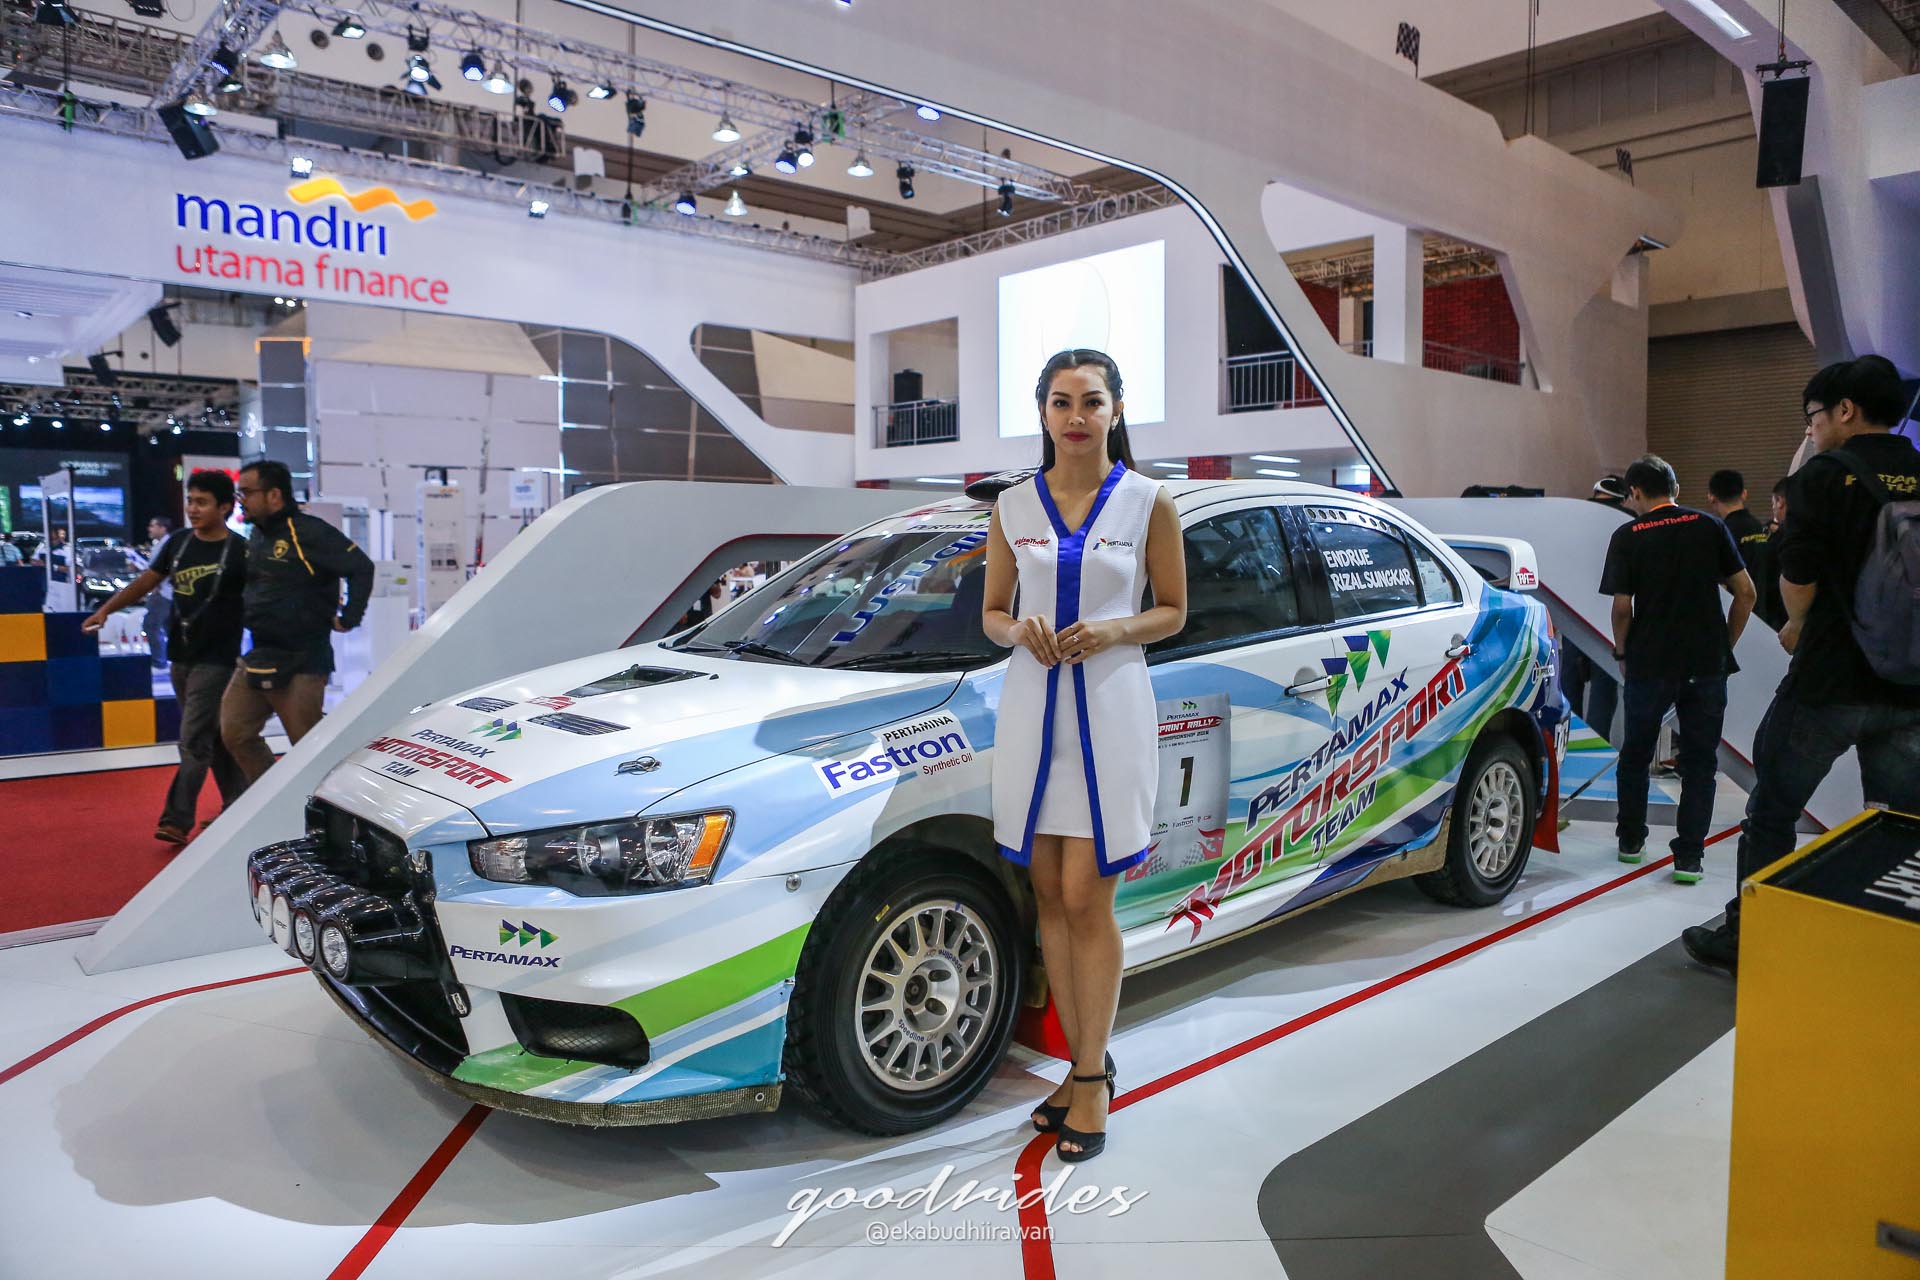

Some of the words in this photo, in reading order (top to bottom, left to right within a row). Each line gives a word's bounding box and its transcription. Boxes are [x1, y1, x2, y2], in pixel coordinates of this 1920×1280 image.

[176, 192, 386, 255] mandiri
[176, 244, 304, 287] utama
[316, 253, 449, 305] finance
[1632, 513, 1700, 533] #RaiseTheBar
[1323, 549, 1374, 568] ENDRUE
[1330, 571, 1367, 592] RIZAL
[1363, 567, 1415, 589] SUNGKAR
[883, 715, 954, 742] PERTAMINA
[1157, 722, 1185, 734] PRINT
[1187, 718, 1214, 729] RALLY
[1167, 712, 1199, 720] PERTAMAX
[411, 729, 496, 759] PERTAMAX
[1246, 666, 1410, 832] PERTAMAX
[366, 736, 513, 790] MOTORSPORT
[380, 761, 420, 778] TEAM
[821, 732, 966, 790] Fastron
[922, 758, 961, 775] Synthetic
[961, 753, 973, 763] Oil
[1179, 756, 1194, 807] 1
[1164, 656, 1469, 944] MOTORSPORT
[1311, 779, 1378, 857] TEAM
[449, 945, 561, 968] PERTAMAX
[898, 1019, 925, 1042] speedline
